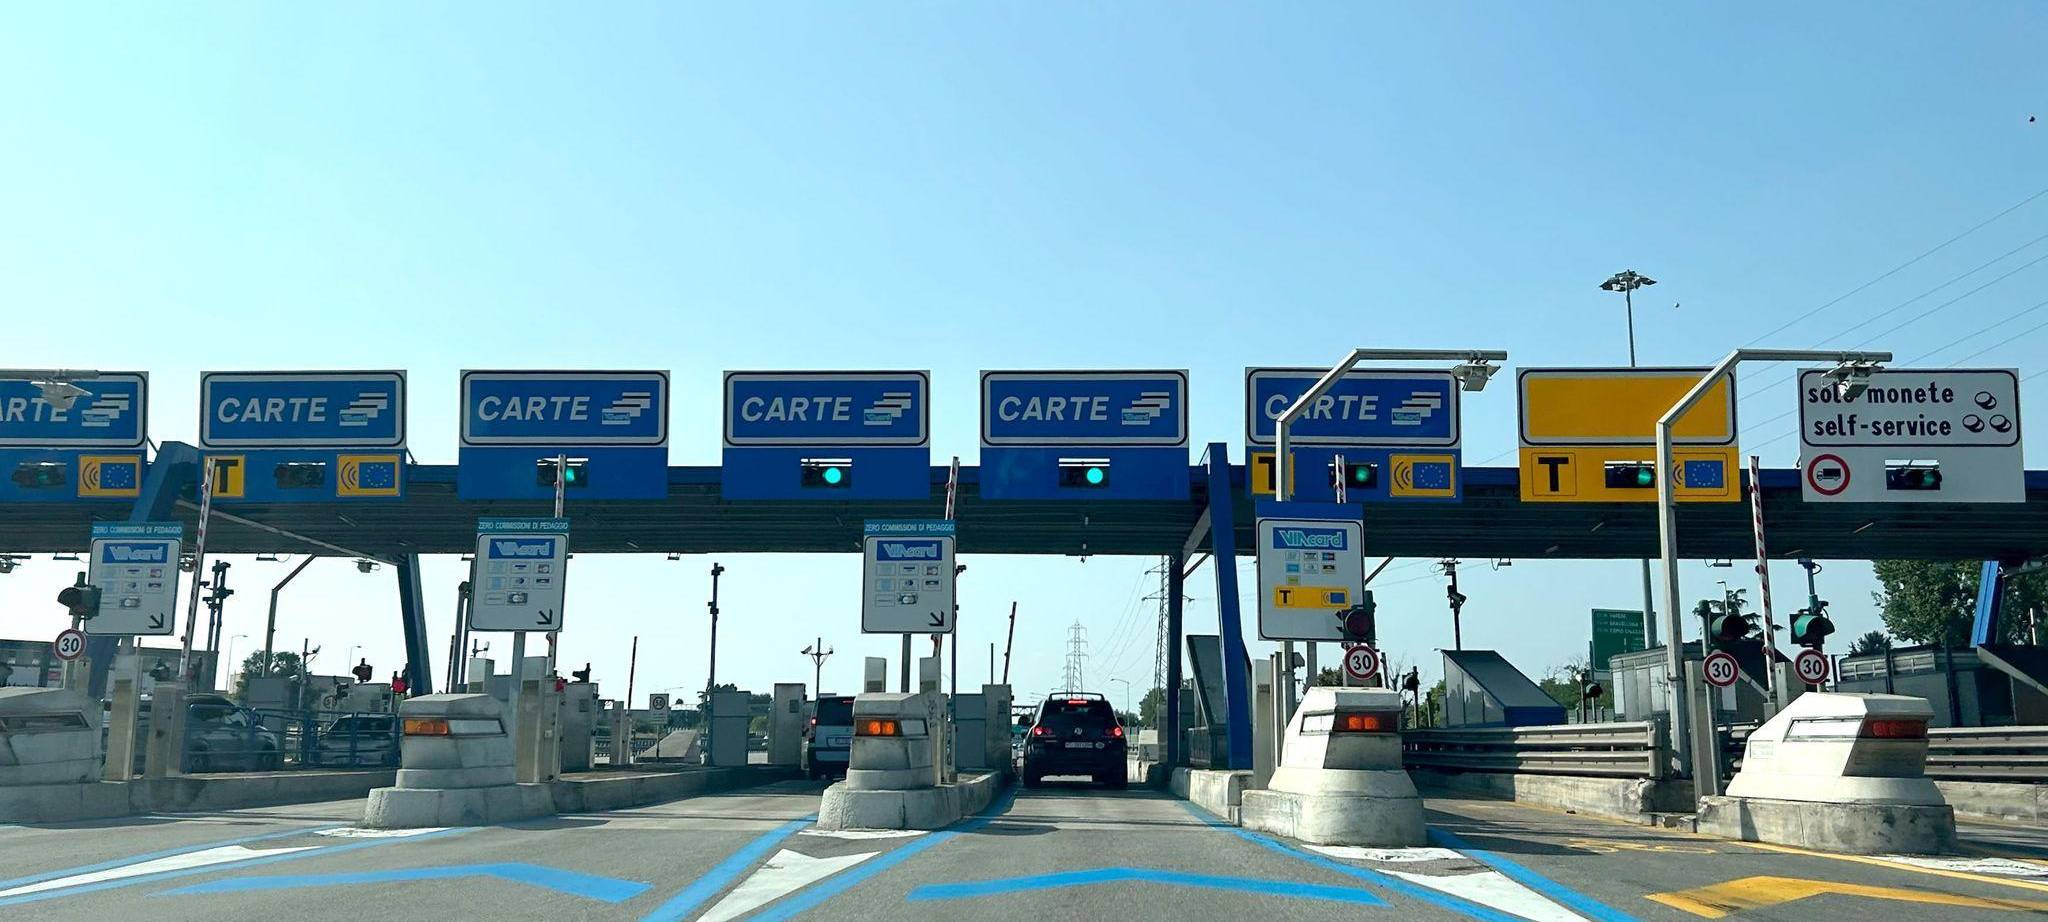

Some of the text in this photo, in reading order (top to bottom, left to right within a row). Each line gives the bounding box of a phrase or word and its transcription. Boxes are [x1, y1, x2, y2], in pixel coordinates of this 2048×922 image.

[1808, 381, 1954, 403] sol monete
[217, 397, 328, 423] CARTE
[478, 396, 590, 421] CARTE
[741, 396, 852, 422] CARTE
[998, 396, 1110, 421] CARTE
[1814, 413, 1952, 436] self-service
[215, 459, 239, 493] T
[1537, 457, 1569, 492] T
[478, 521, 494, 530] ZERO
[865, 523, 880, 532] ZERO
[1279, 530, 1343, 547] VIAcard
[1279, 589, 1291, 604] T
[62, 637, 79, 652] 30
[1352, 654, 1371, 670] 30
[1712, 662, 1732, 678] 30
[1803, 659, 1820, 675] 30
